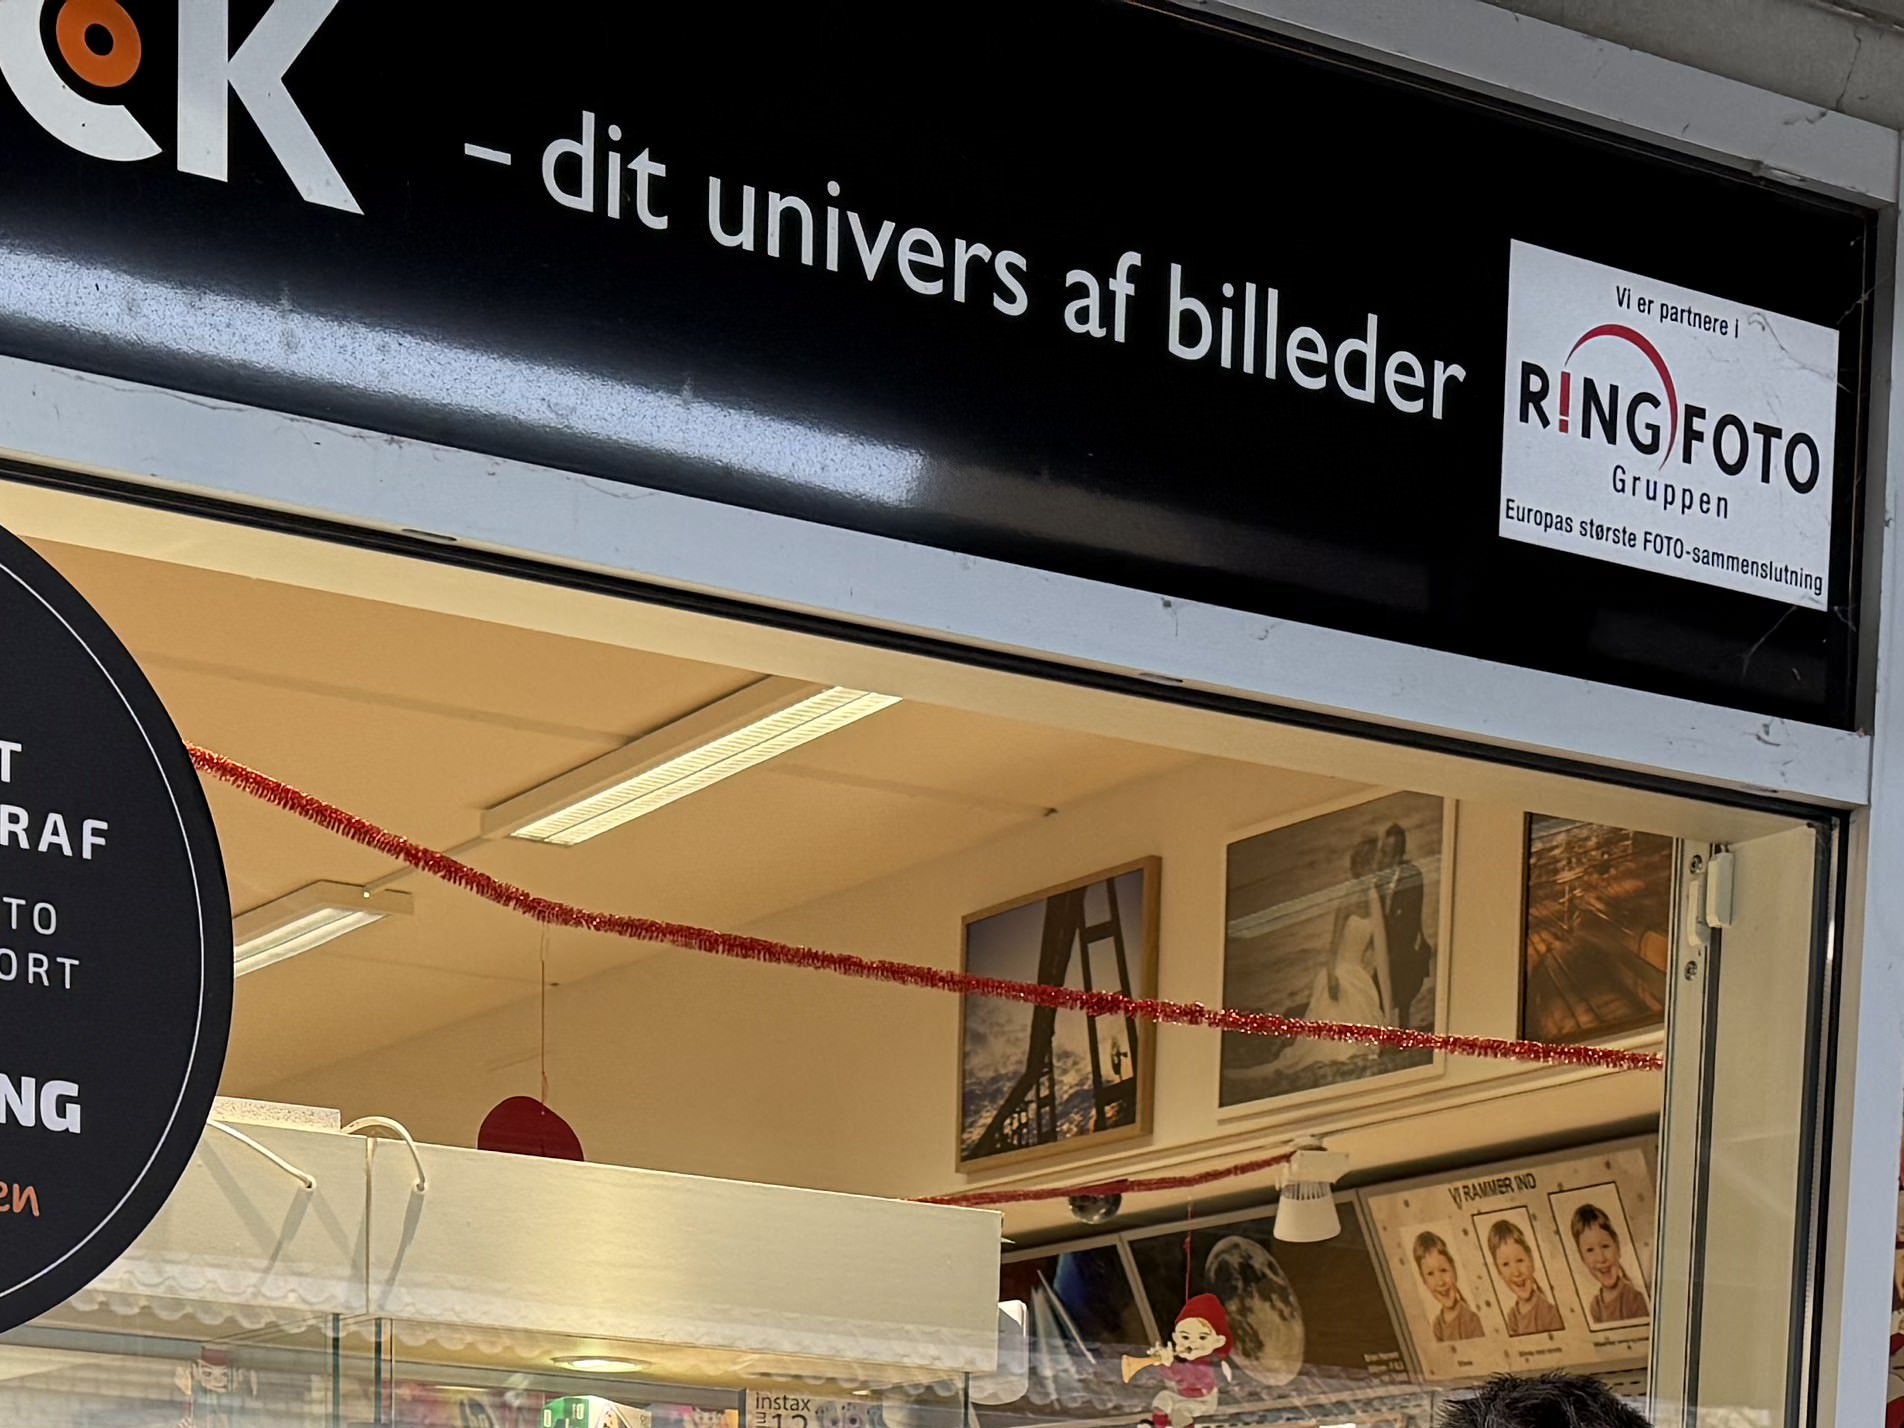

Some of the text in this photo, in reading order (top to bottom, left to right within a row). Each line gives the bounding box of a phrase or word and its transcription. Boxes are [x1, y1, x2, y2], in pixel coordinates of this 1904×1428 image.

[541, 111, 1467, 421] dit univers af billeder
[1616, 285, 1728, 337] Vi er partnere
[1611, 464, 1729, 519] Gruppen
[1505, 498, 1823, 596] Europas største FOTO-sammenslutning
[755, 1392, 811, 1412] instax
